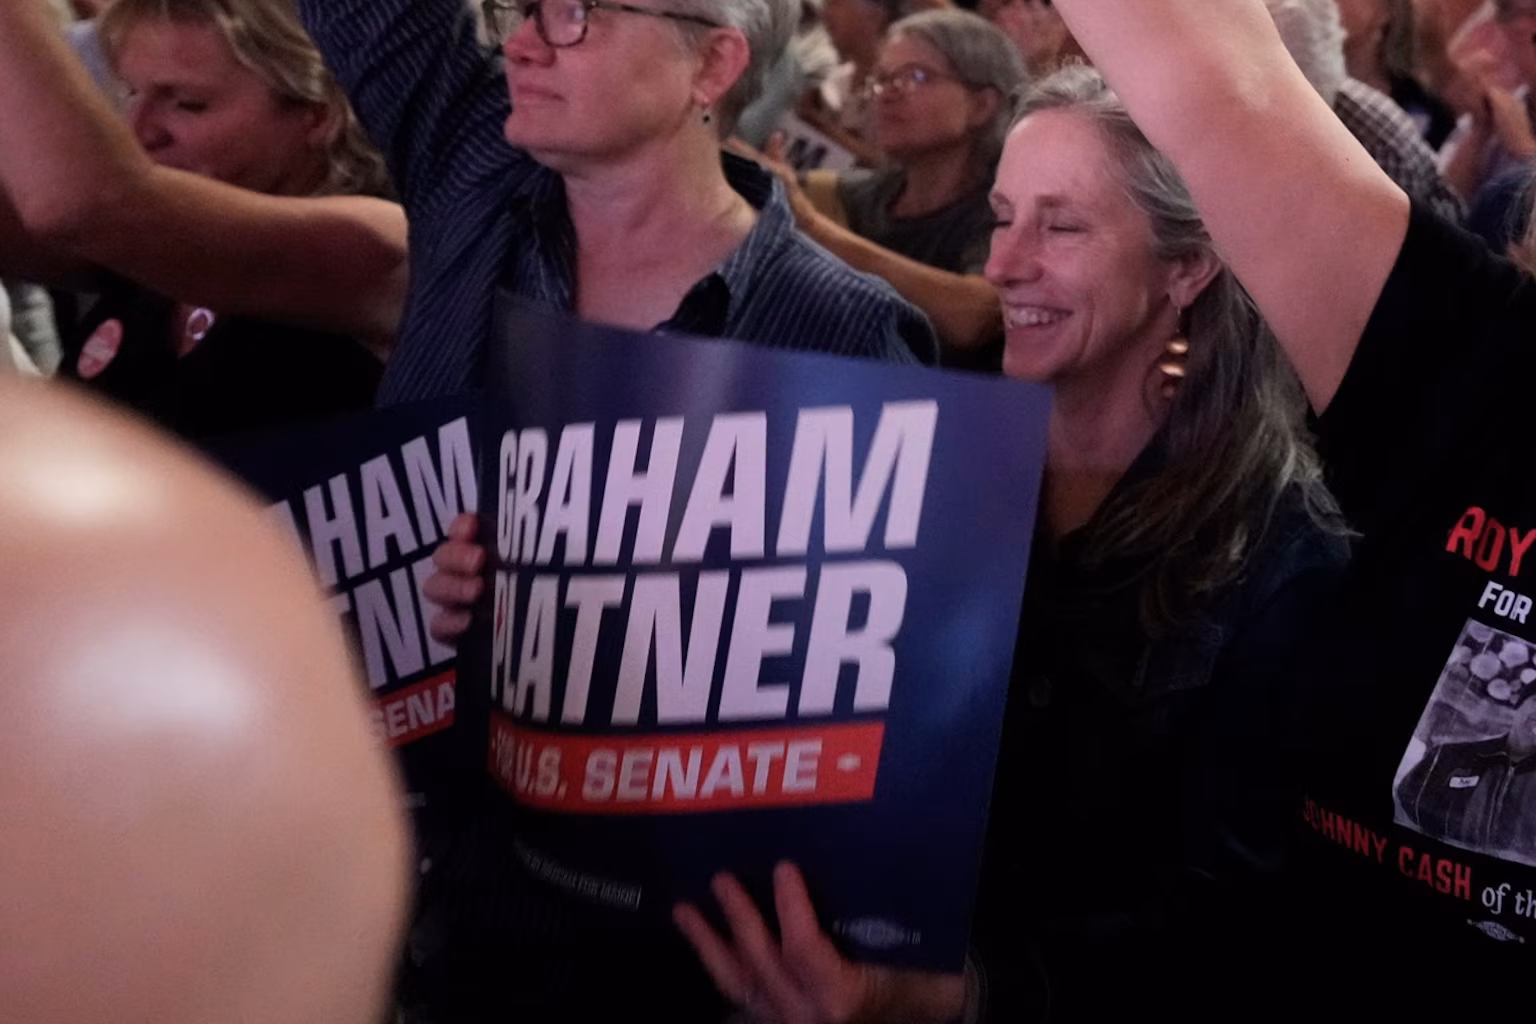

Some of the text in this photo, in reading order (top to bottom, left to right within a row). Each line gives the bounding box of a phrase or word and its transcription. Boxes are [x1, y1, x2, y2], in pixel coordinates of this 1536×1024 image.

[496, 399, 939, 565] GRAHAM
[1478, 580, 1533, 625] FOR
[491, 560, 908, 726] PLATNER
[580, 738, 823, 803] SENATE
[1398, 845, 1473, 901] CASH
[1481, 882, 1512, 915] of
